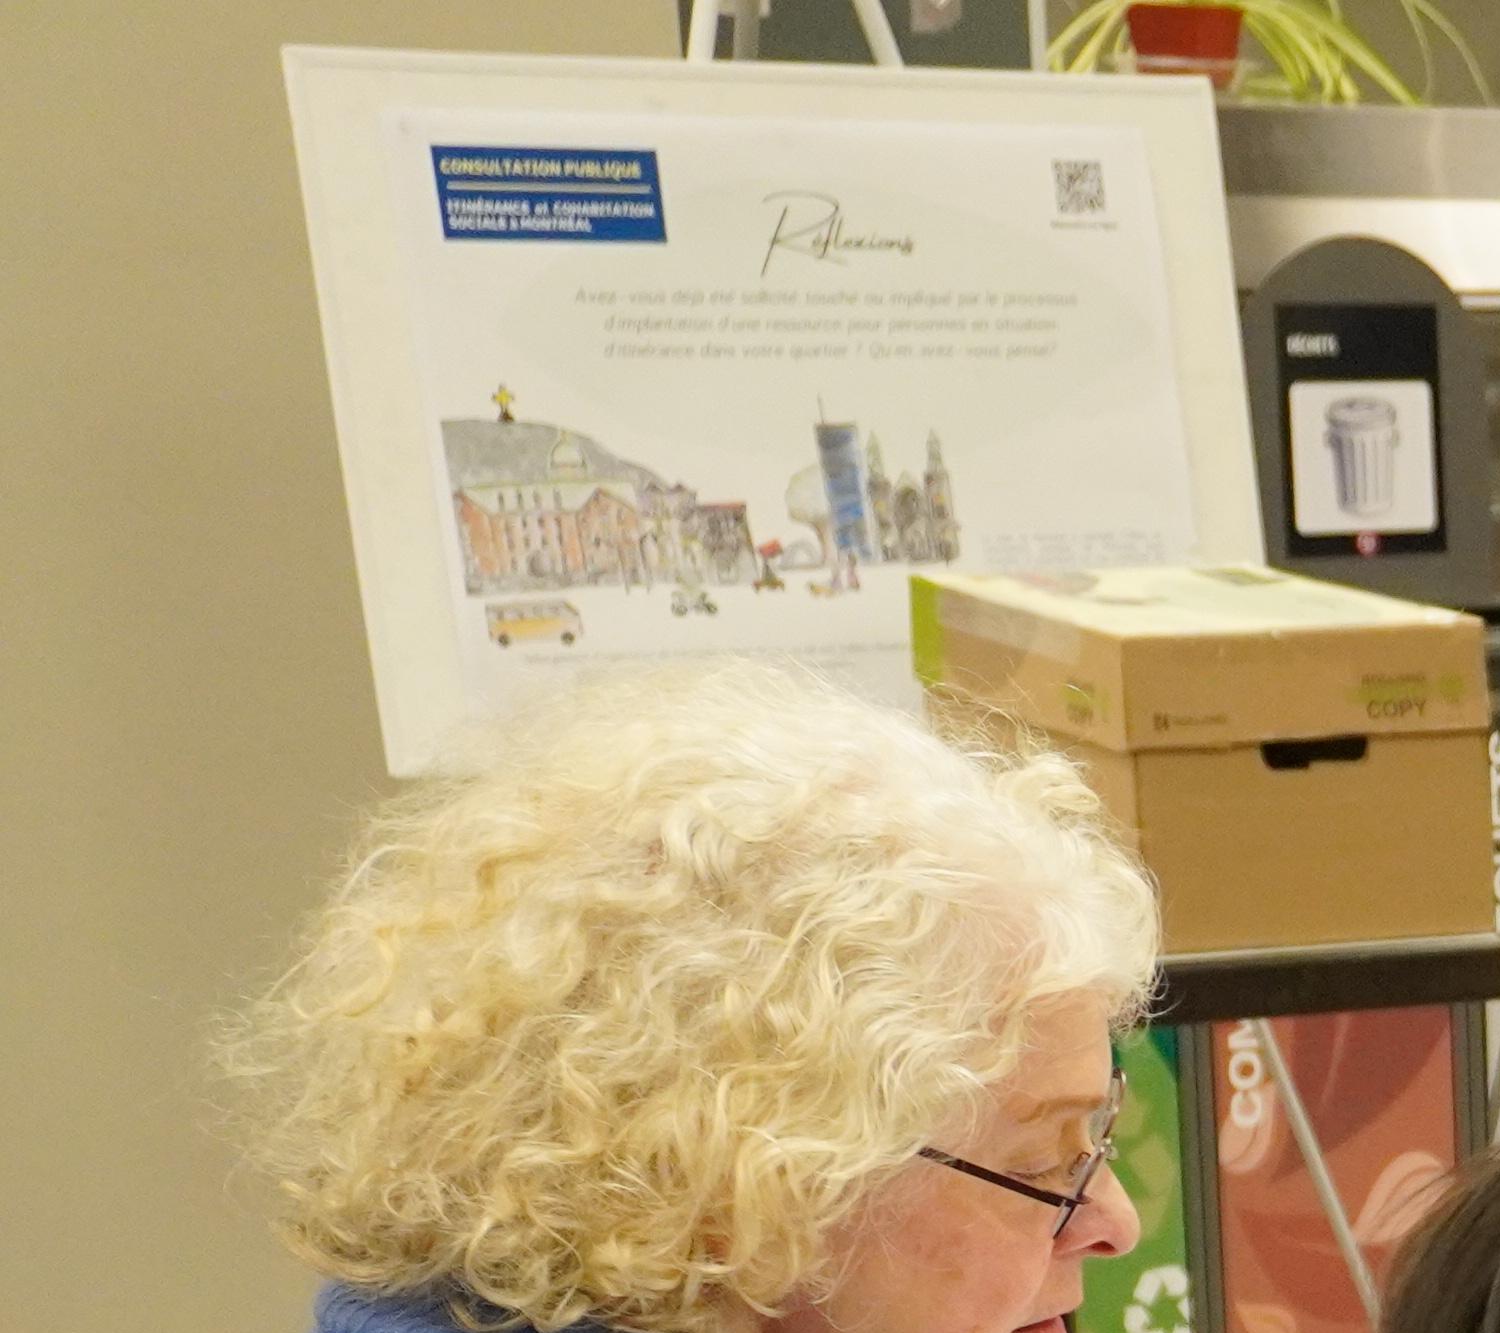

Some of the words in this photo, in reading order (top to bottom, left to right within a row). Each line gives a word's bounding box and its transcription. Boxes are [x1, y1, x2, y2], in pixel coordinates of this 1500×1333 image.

[440, 157, 561, 177] CONSULTATION
[563, 160, 642, 181] PUBLIQUE
[1366, 699, 1427, 719] COPY
